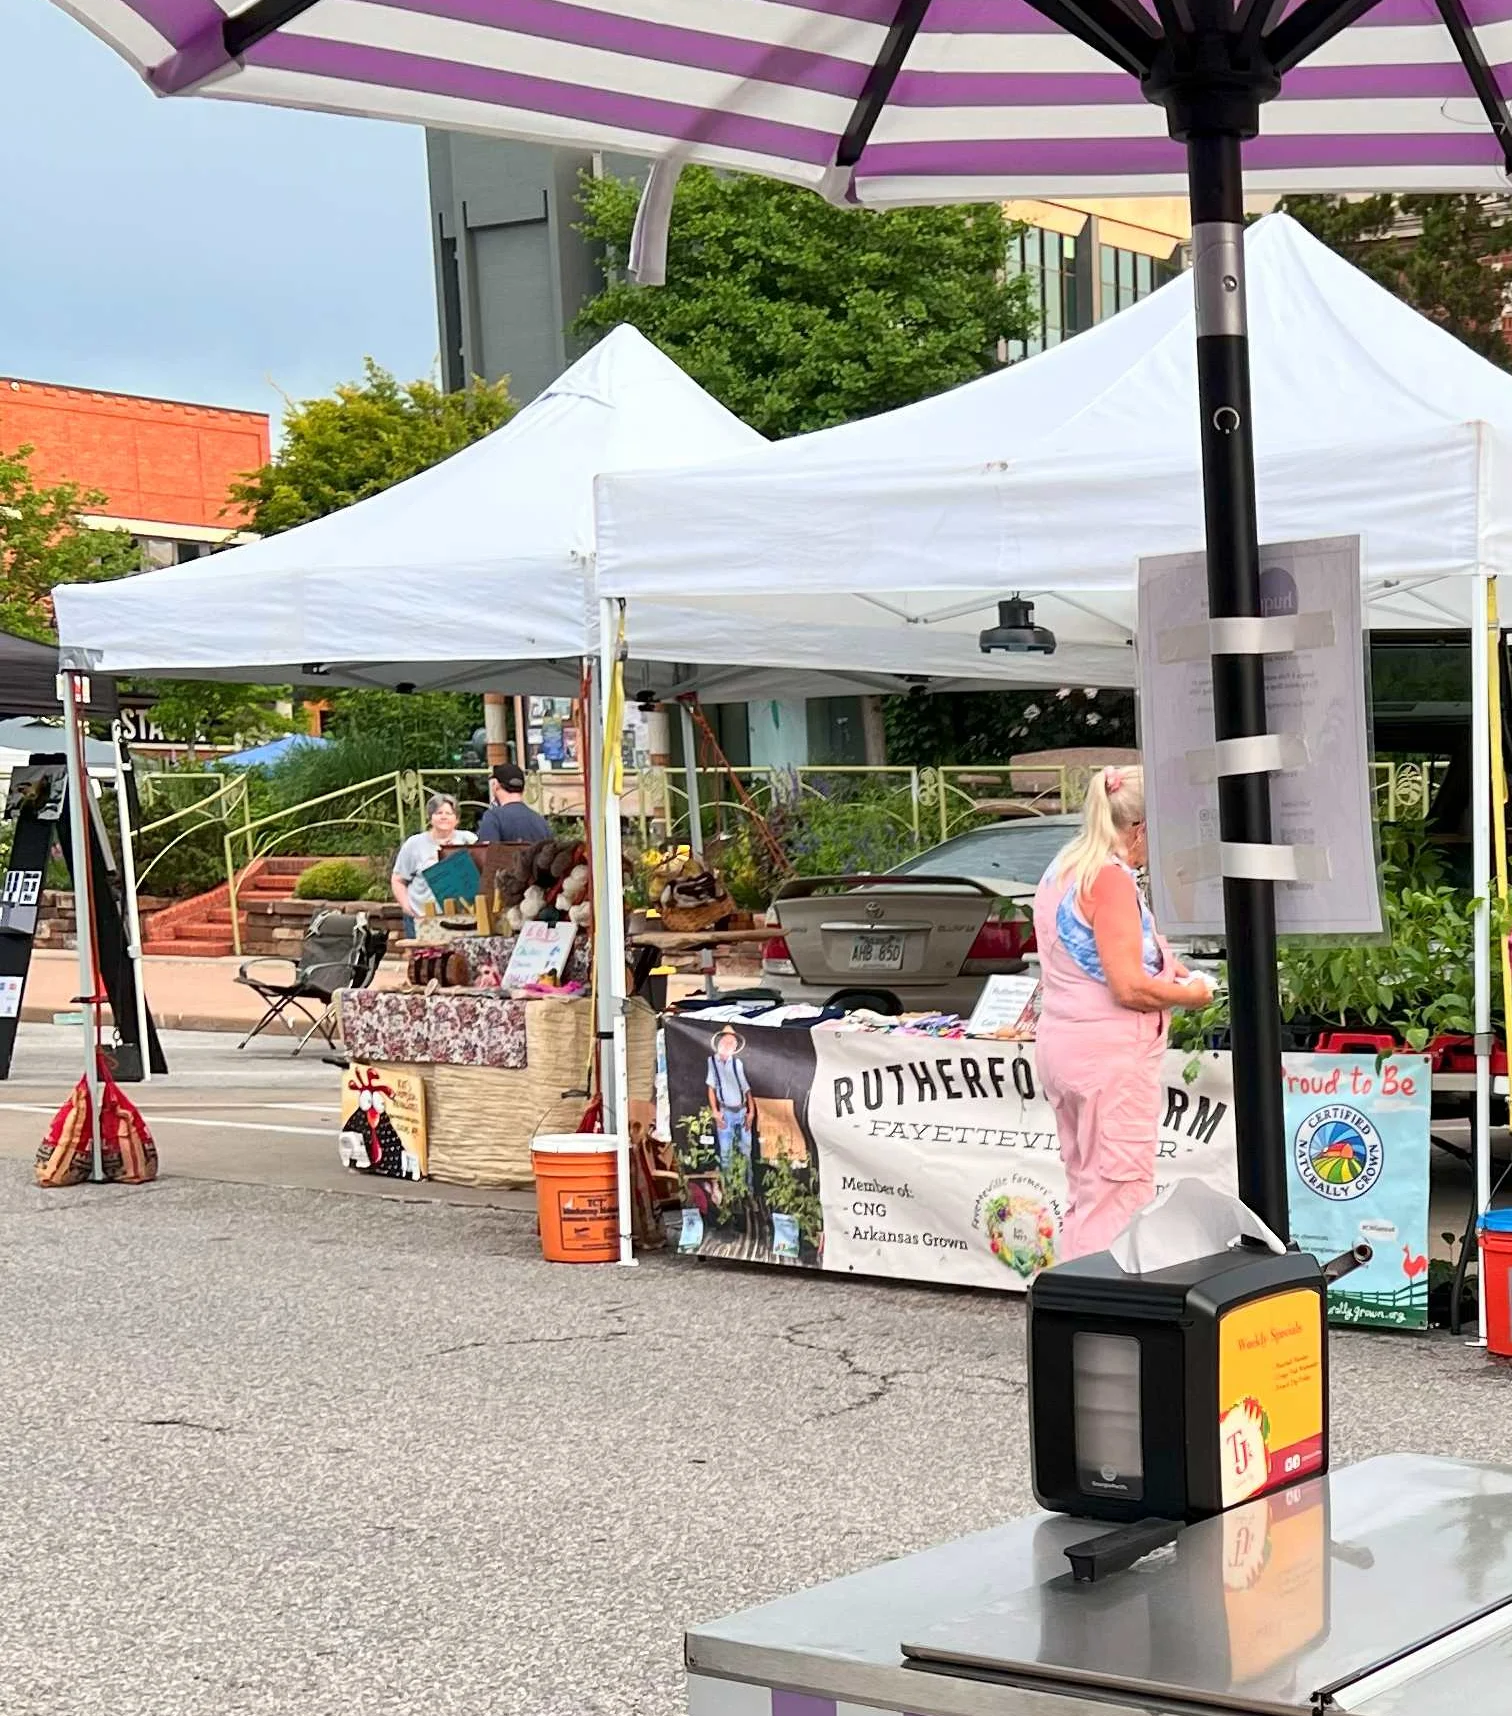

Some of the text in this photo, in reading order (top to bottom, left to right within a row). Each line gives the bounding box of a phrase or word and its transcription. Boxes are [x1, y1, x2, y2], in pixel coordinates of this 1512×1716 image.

[851, 944, 873, 961] AHB
[1281, 1064, 1417, 1096] roud to Be
[833, 1056, 1228, 1145] RUTHERFO RM
[867, 1119, 1062, 1151] FAYETTEVI
[1308, 1107, 1371, 1136] CERTIFIED
[1298, 1139, 1379, 1197] NATURALLY GROWN
[841, 1176, 895, 1196] Member
[852, 1201, 887, 1219] CNG
[852, 1225, 969, 1250] Arkansas Grown
[1270, 1321, 1304, 1345] Specials
